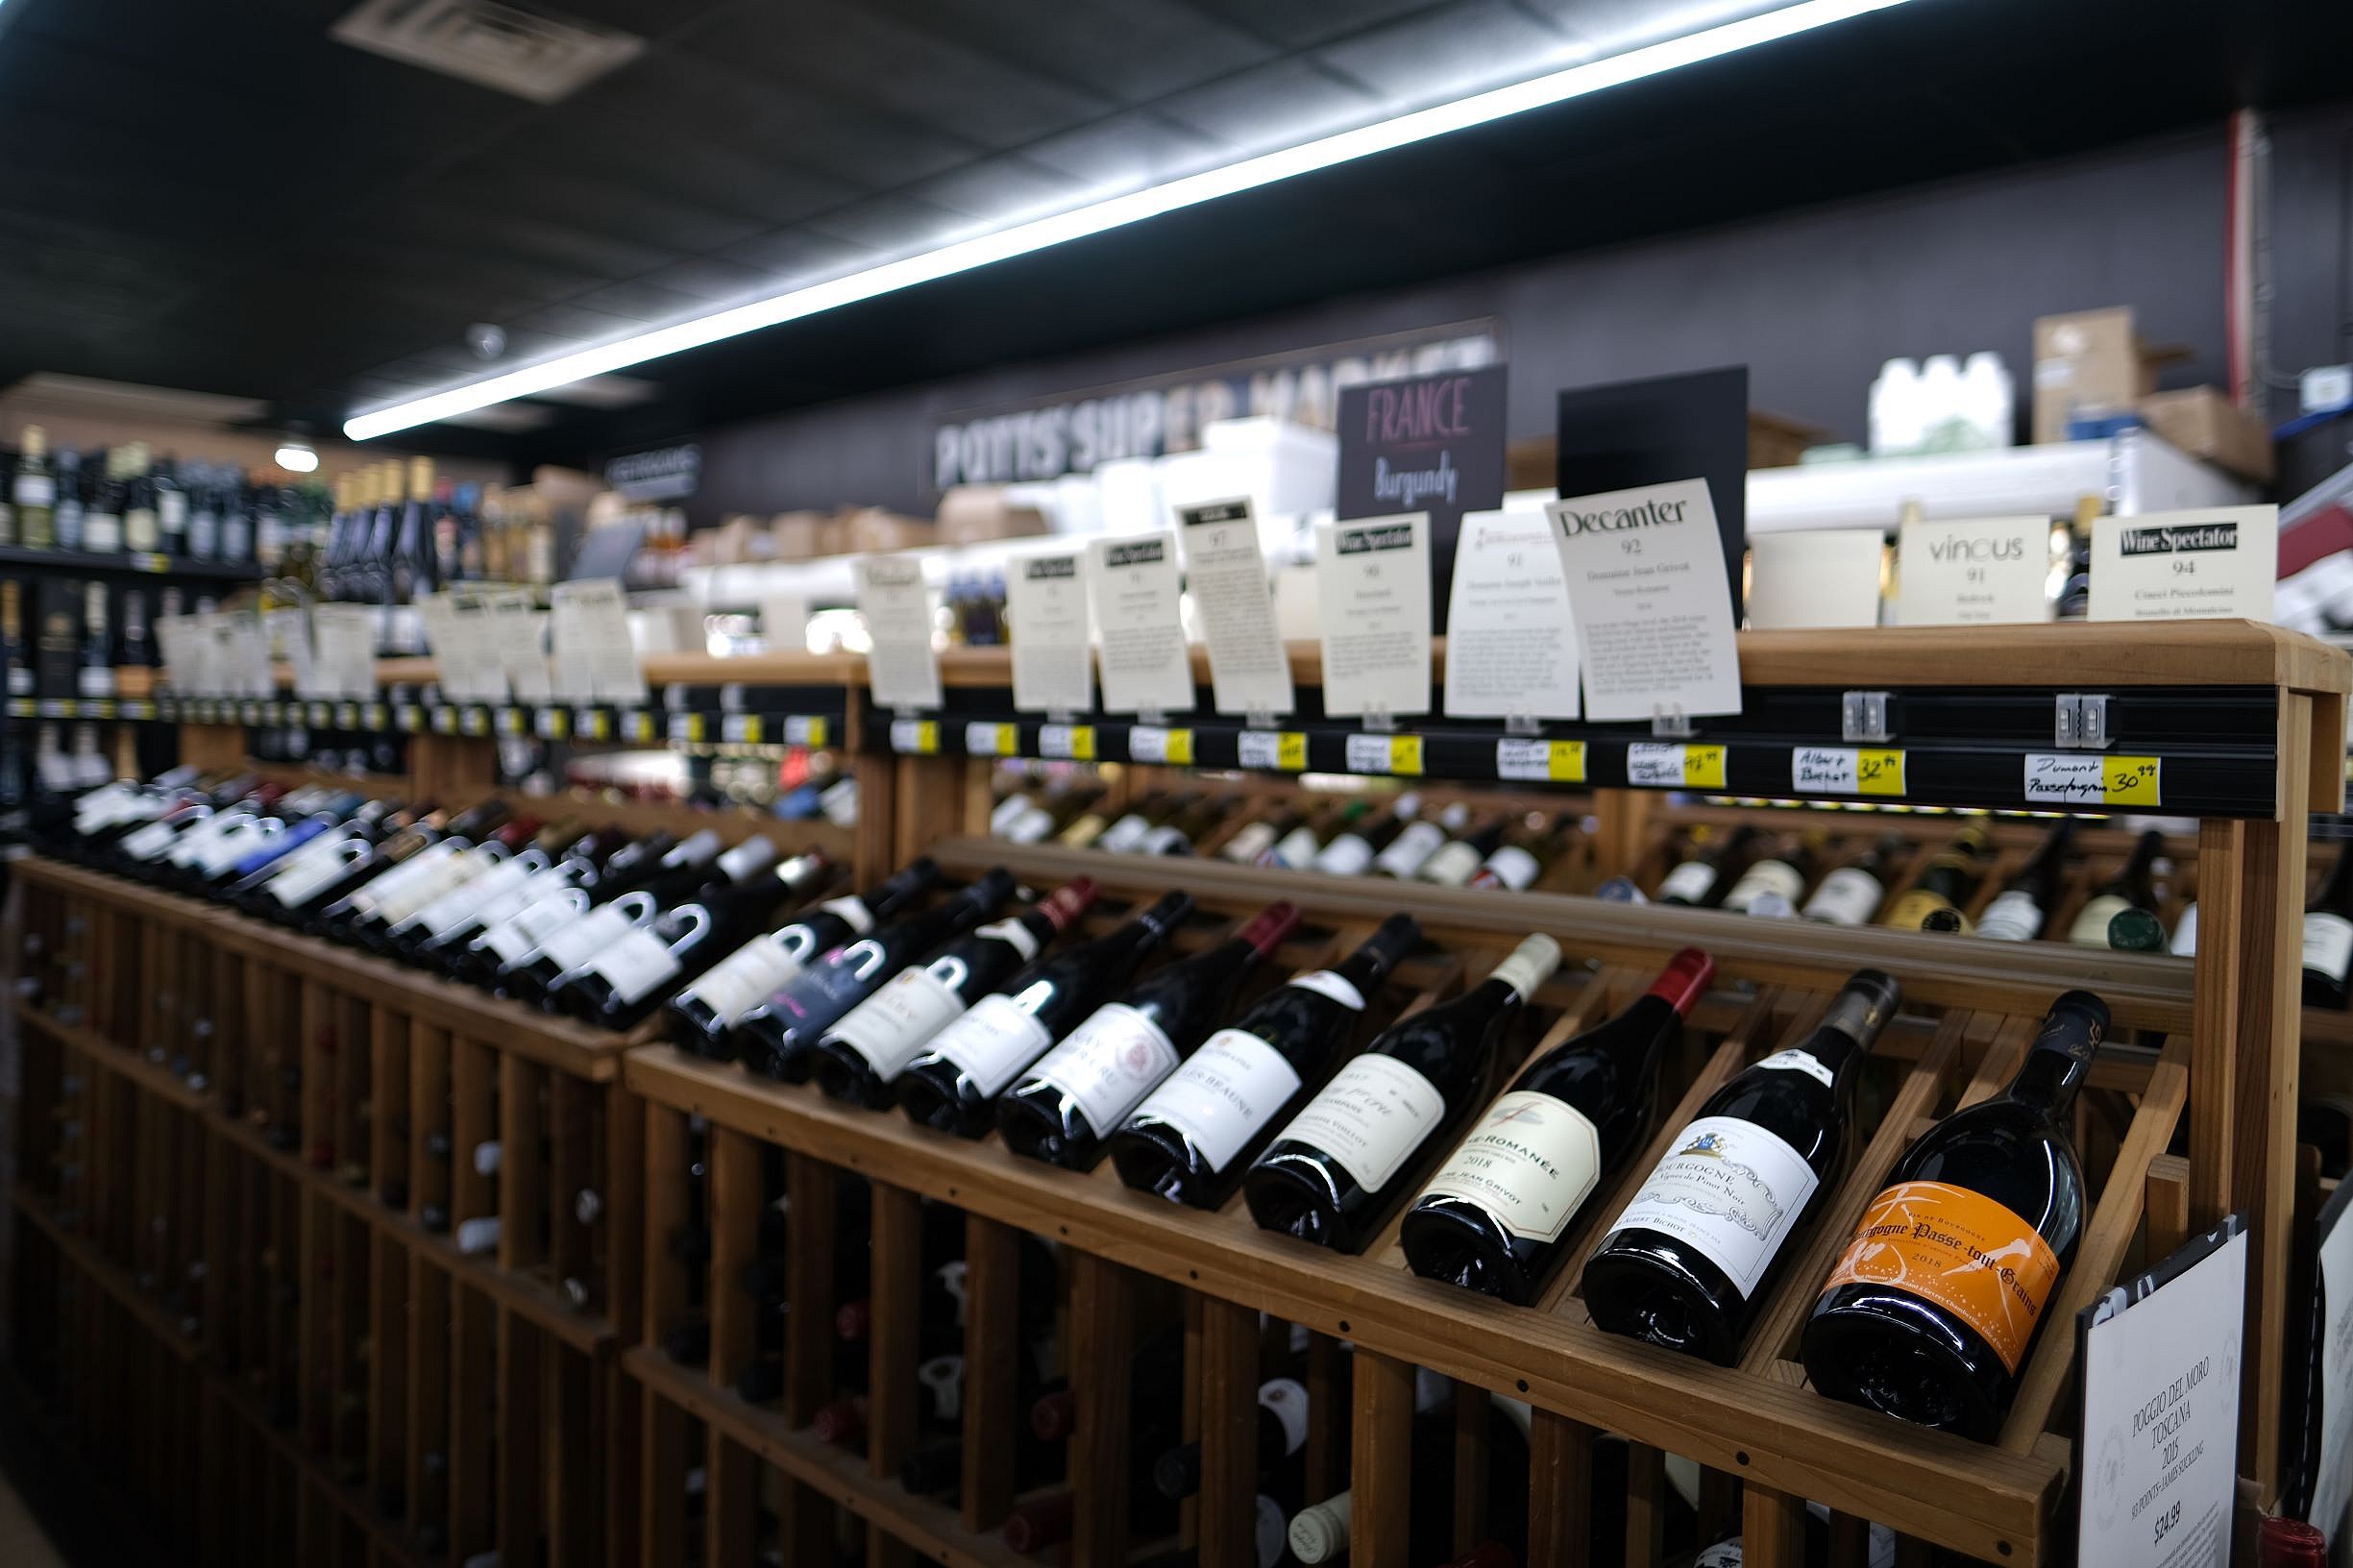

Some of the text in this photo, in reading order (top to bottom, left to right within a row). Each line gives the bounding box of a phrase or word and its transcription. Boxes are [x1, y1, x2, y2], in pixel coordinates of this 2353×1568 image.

[1366, 377, 1470, 444] FRANCE
[1374, 450, 1459, 507] Burgundy
[1558, 499, 1687, 537] Decanter
[1621, 539, 1642, 554] 92
[2121, 524, 2237, 553] Wine Spectator
[1967, 567, 1985, 584] 91
[2172, 560, 2195, 576] 94
[1912, 1252, 1943, 1268] 2018
[2132, 1356, 2211, 1438] POGGIO DEL MORO
[2151, 1399, 2192, 1450] TOSCANA
[2162, 1436, 2179, 1470] 2015
[2154, 1499, 2181, 1547] $24.99
